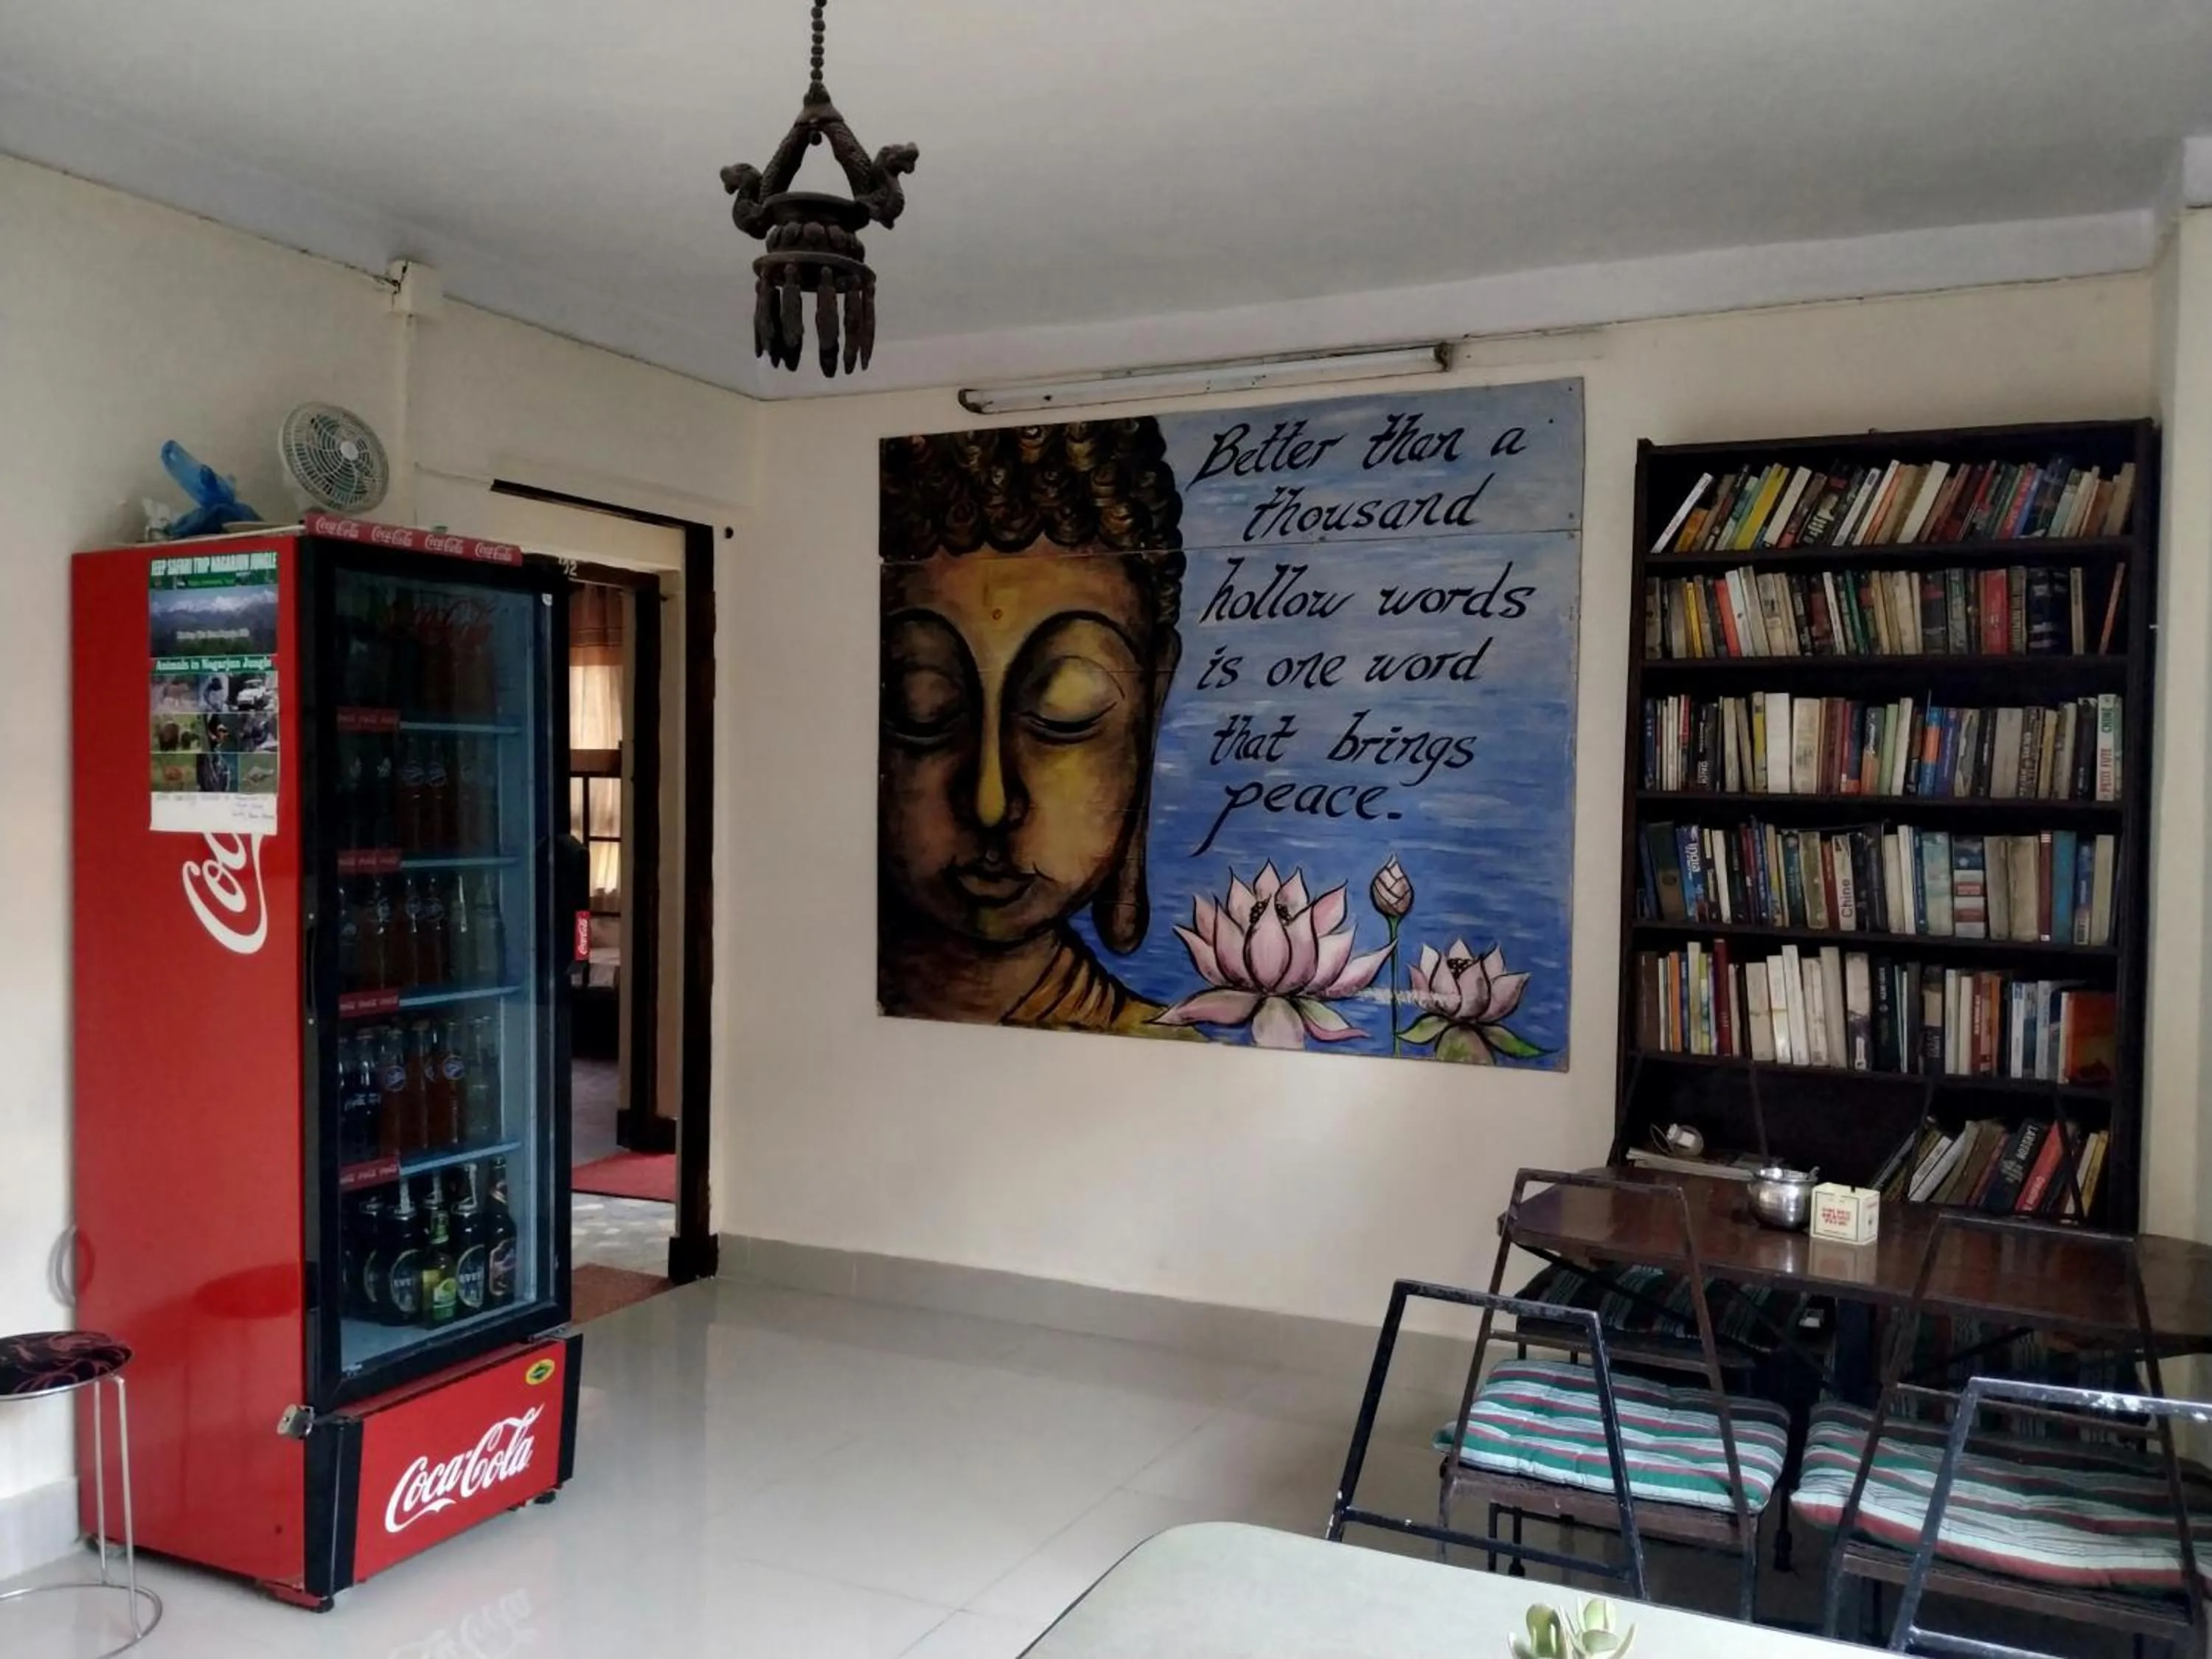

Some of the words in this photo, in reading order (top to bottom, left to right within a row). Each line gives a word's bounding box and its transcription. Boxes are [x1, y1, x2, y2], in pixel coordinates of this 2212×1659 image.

[1185, 419, 1348, 490] Better
[1363, 413, 1464, 470] than
[1490, 427, 1526, 458] a
[1242, 473, 1495, 542] thousand
[1200, 557, 1354, 622] hollow
[1380, 561, 1536, 619] words
[1197, 645, 1244, 690] is
[1267, 652, 1346, 689] one
[1365, 636, 1493, 682] word
[1209, 714, 1298, 765] that
[1328, 709, 1477, 787] brings
[1189, 781, 1402, 858] peace.
[385, 1403, 545, 1533] Coca-Cola
